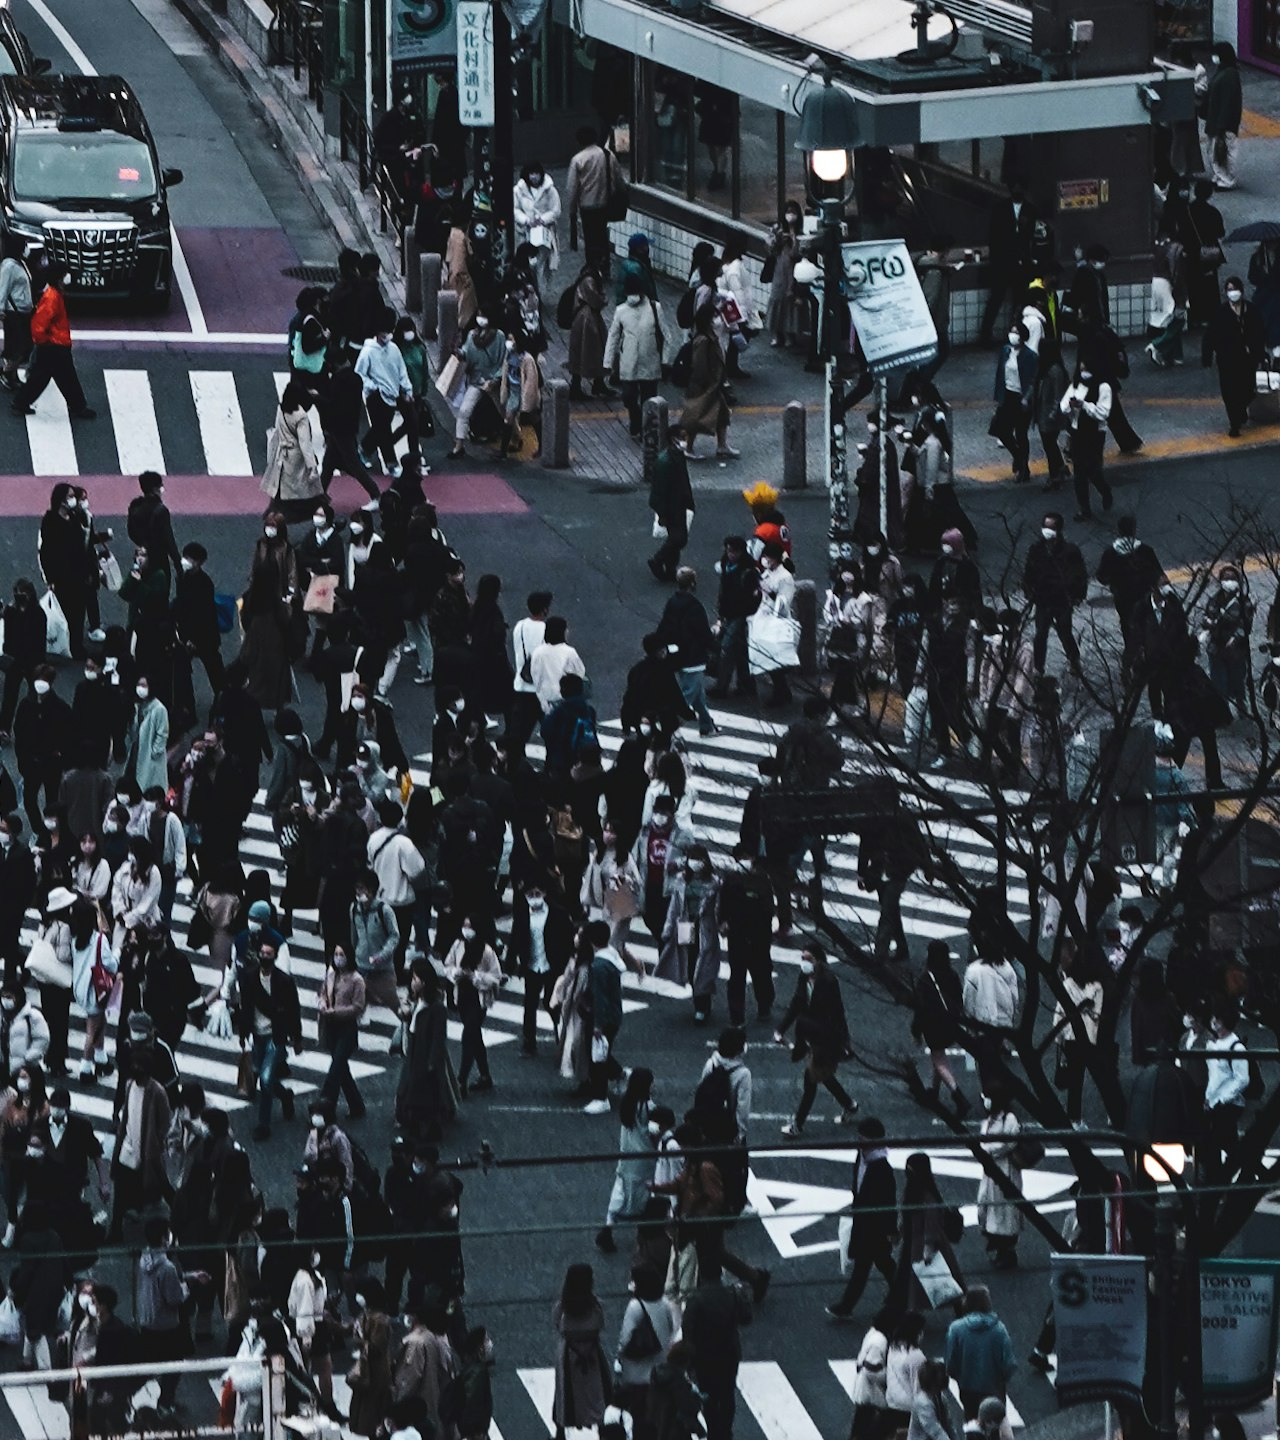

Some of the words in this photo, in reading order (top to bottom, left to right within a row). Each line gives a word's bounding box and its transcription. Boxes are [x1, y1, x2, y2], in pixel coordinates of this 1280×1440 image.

[1202, 1276, 1251, 1289] TOKYO
[1201, 1288, 1271, 1304] CREATIVE
[1201, 1317, 1239, 1331] 2022
